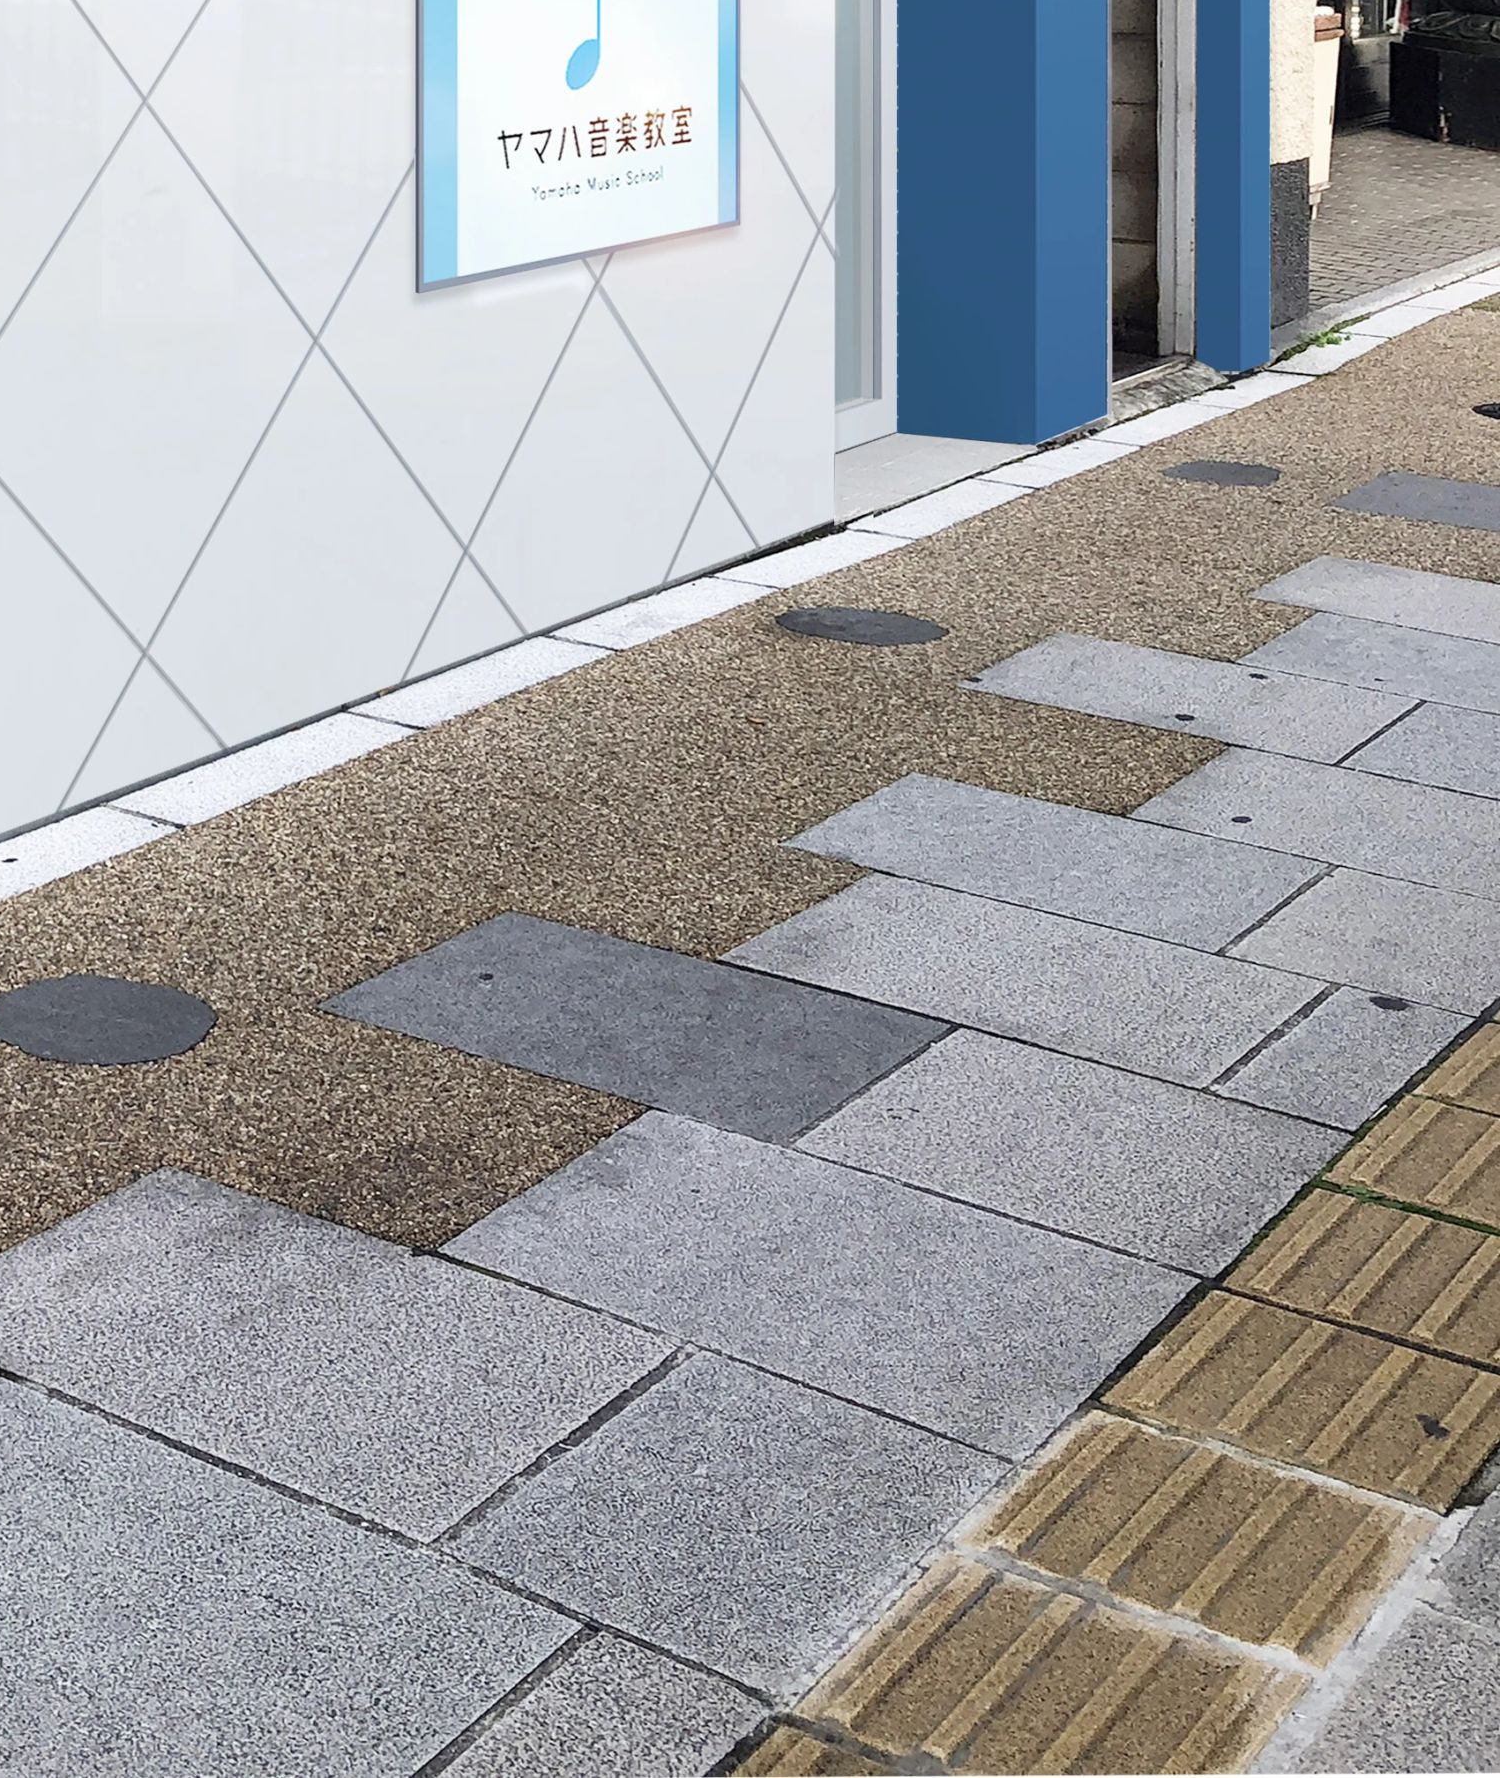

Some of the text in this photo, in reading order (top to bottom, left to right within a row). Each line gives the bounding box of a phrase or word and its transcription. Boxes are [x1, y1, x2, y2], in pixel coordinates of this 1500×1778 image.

[497, 105, 693, 169] ヤマハ音楽教室
